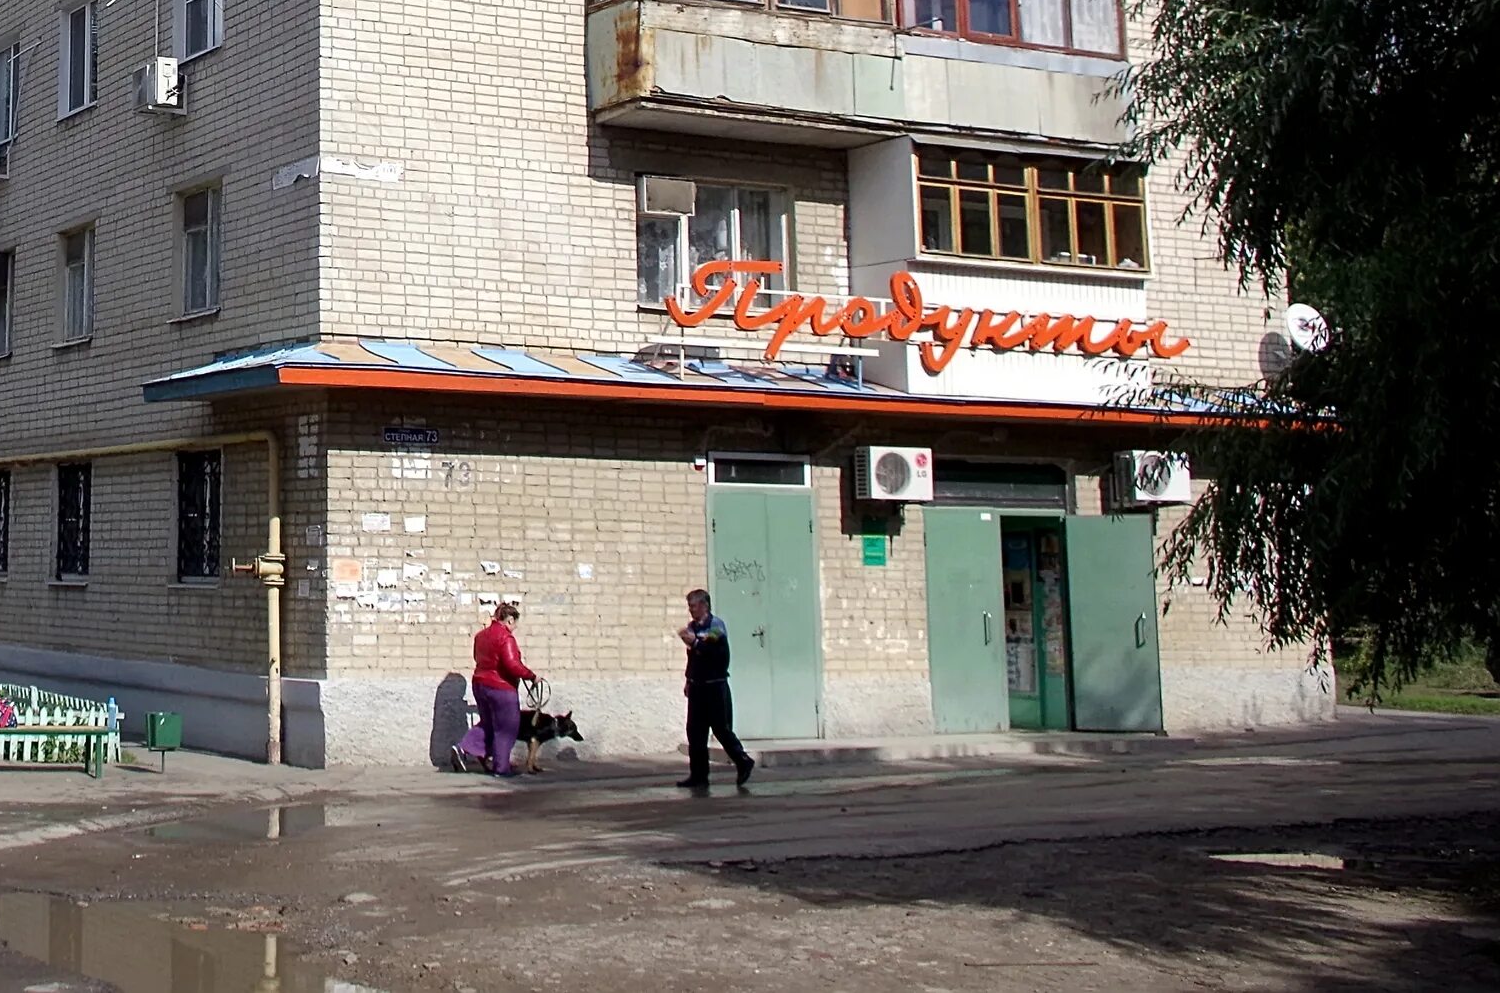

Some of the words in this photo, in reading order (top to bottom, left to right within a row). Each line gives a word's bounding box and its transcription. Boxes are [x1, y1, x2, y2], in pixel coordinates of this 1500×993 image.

[664, 260, 1191, 375] Продукты
[384, 433, 424, 442] СТЕПНАЯ
[426, 430, 438, 443] 73
[916, 470, 927, 478] LG
